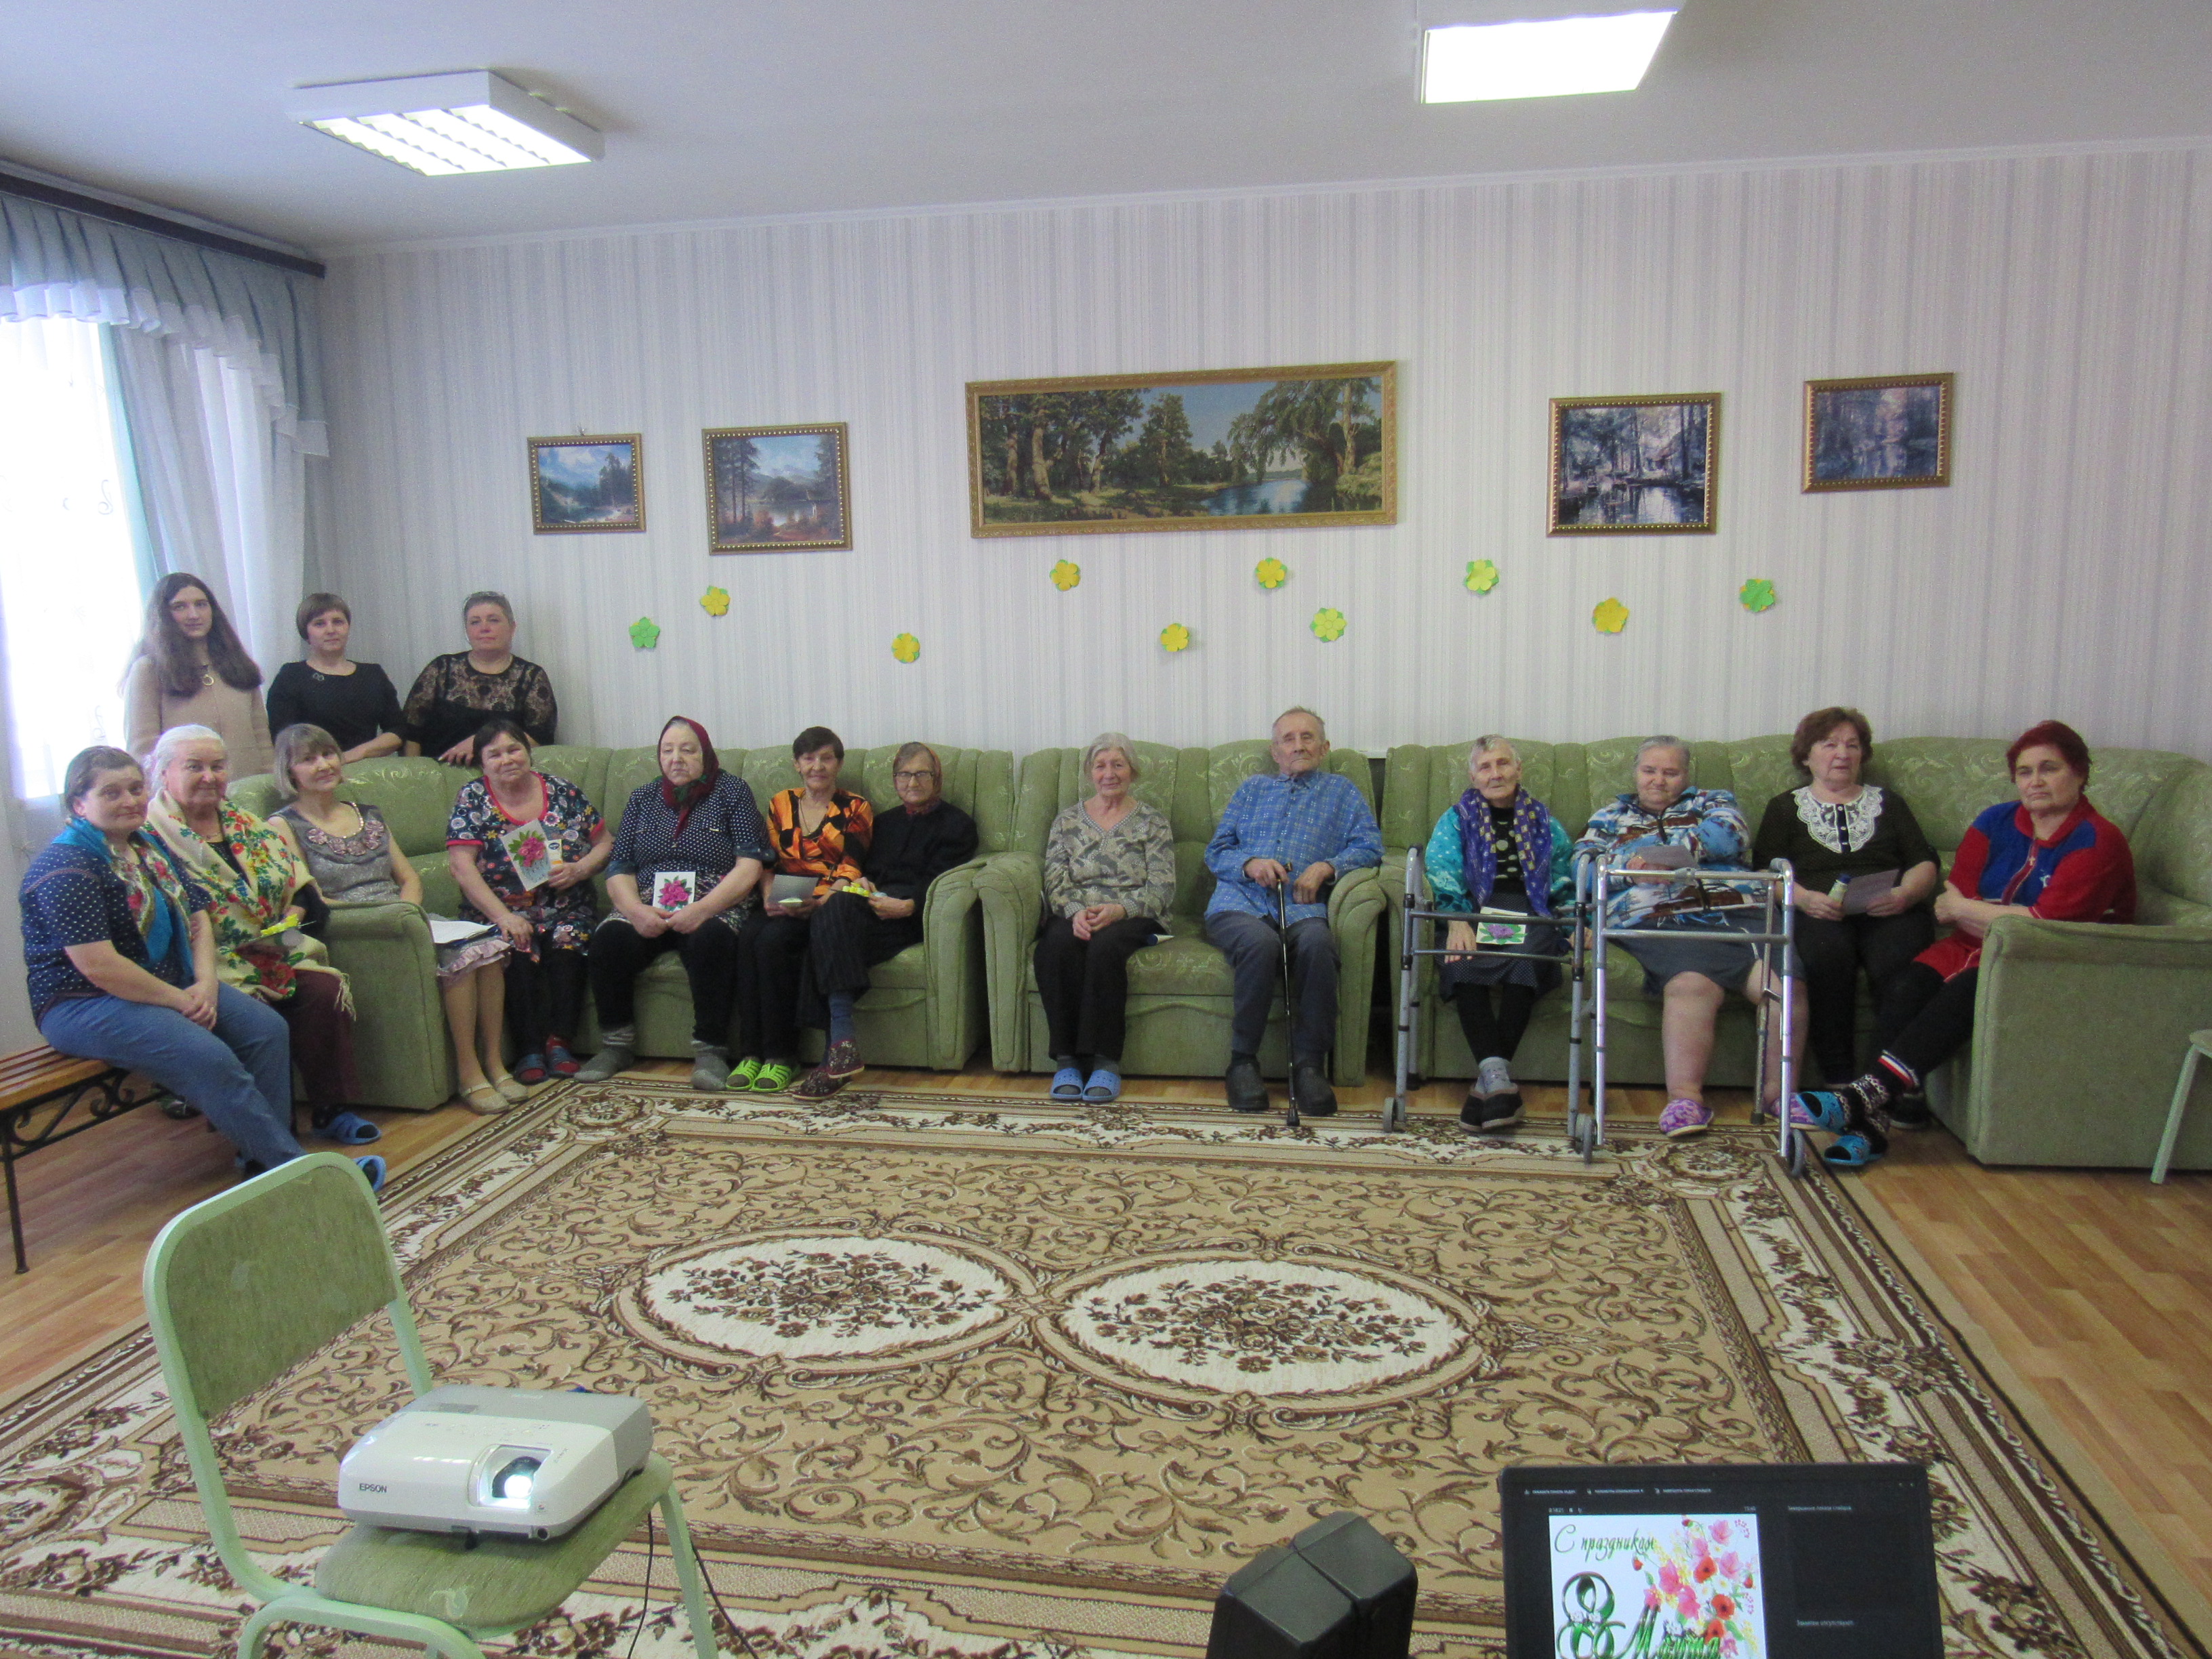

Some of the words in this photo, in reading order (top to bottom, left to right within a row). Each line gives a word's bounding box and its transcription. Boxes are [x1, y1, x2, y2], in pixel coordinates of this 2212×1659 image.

[359, 1483, 387, 1493] EPSON
[1555, 1524, 1576, 1553] С
[1580, 1528, 1655, 1562] праздником
